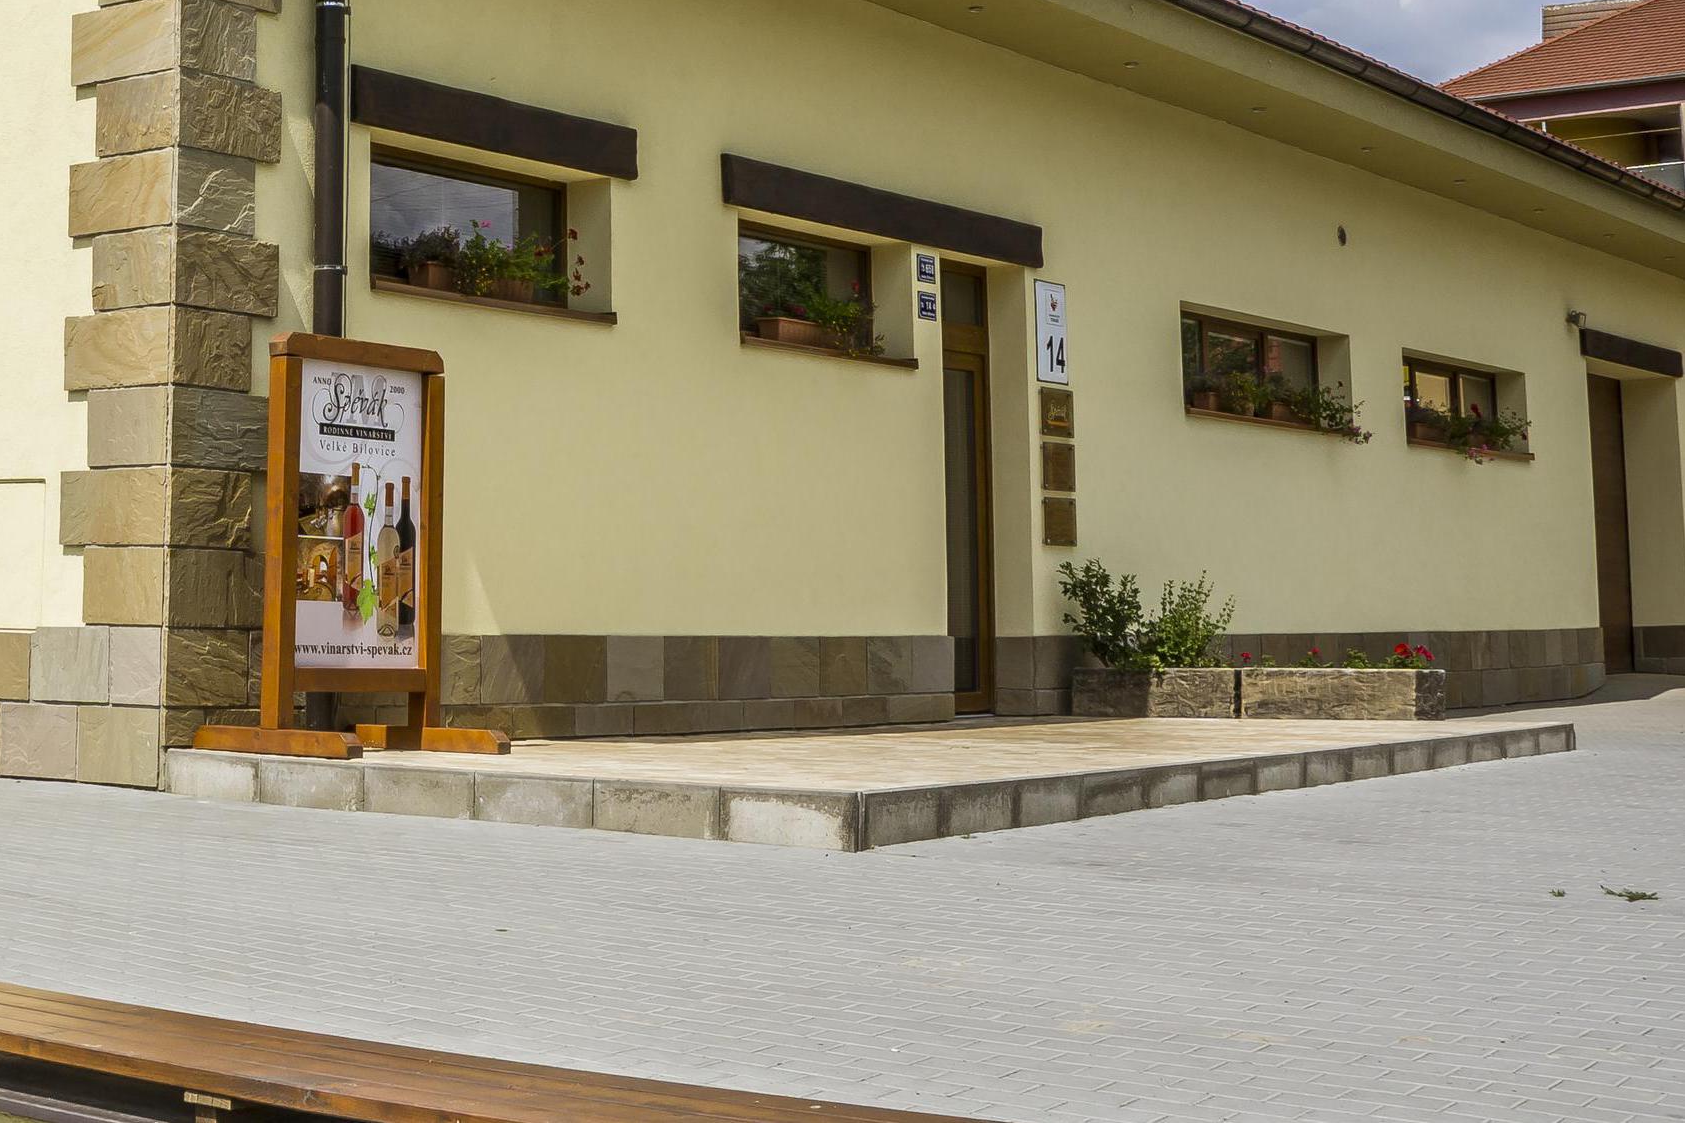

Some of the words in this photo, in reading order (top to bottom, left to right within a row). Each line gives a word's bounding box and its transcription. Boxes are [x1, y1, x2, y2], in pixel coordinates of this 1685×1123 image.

[1046, 335, 1066, 374] 14
[313, 376, 332, 386] ANNO
[389, 385, 405, 395] 2000
[319, 439, 347, 453] Velké
[295, 641, 413, 659] www.vinarstvi-spevak.cz
